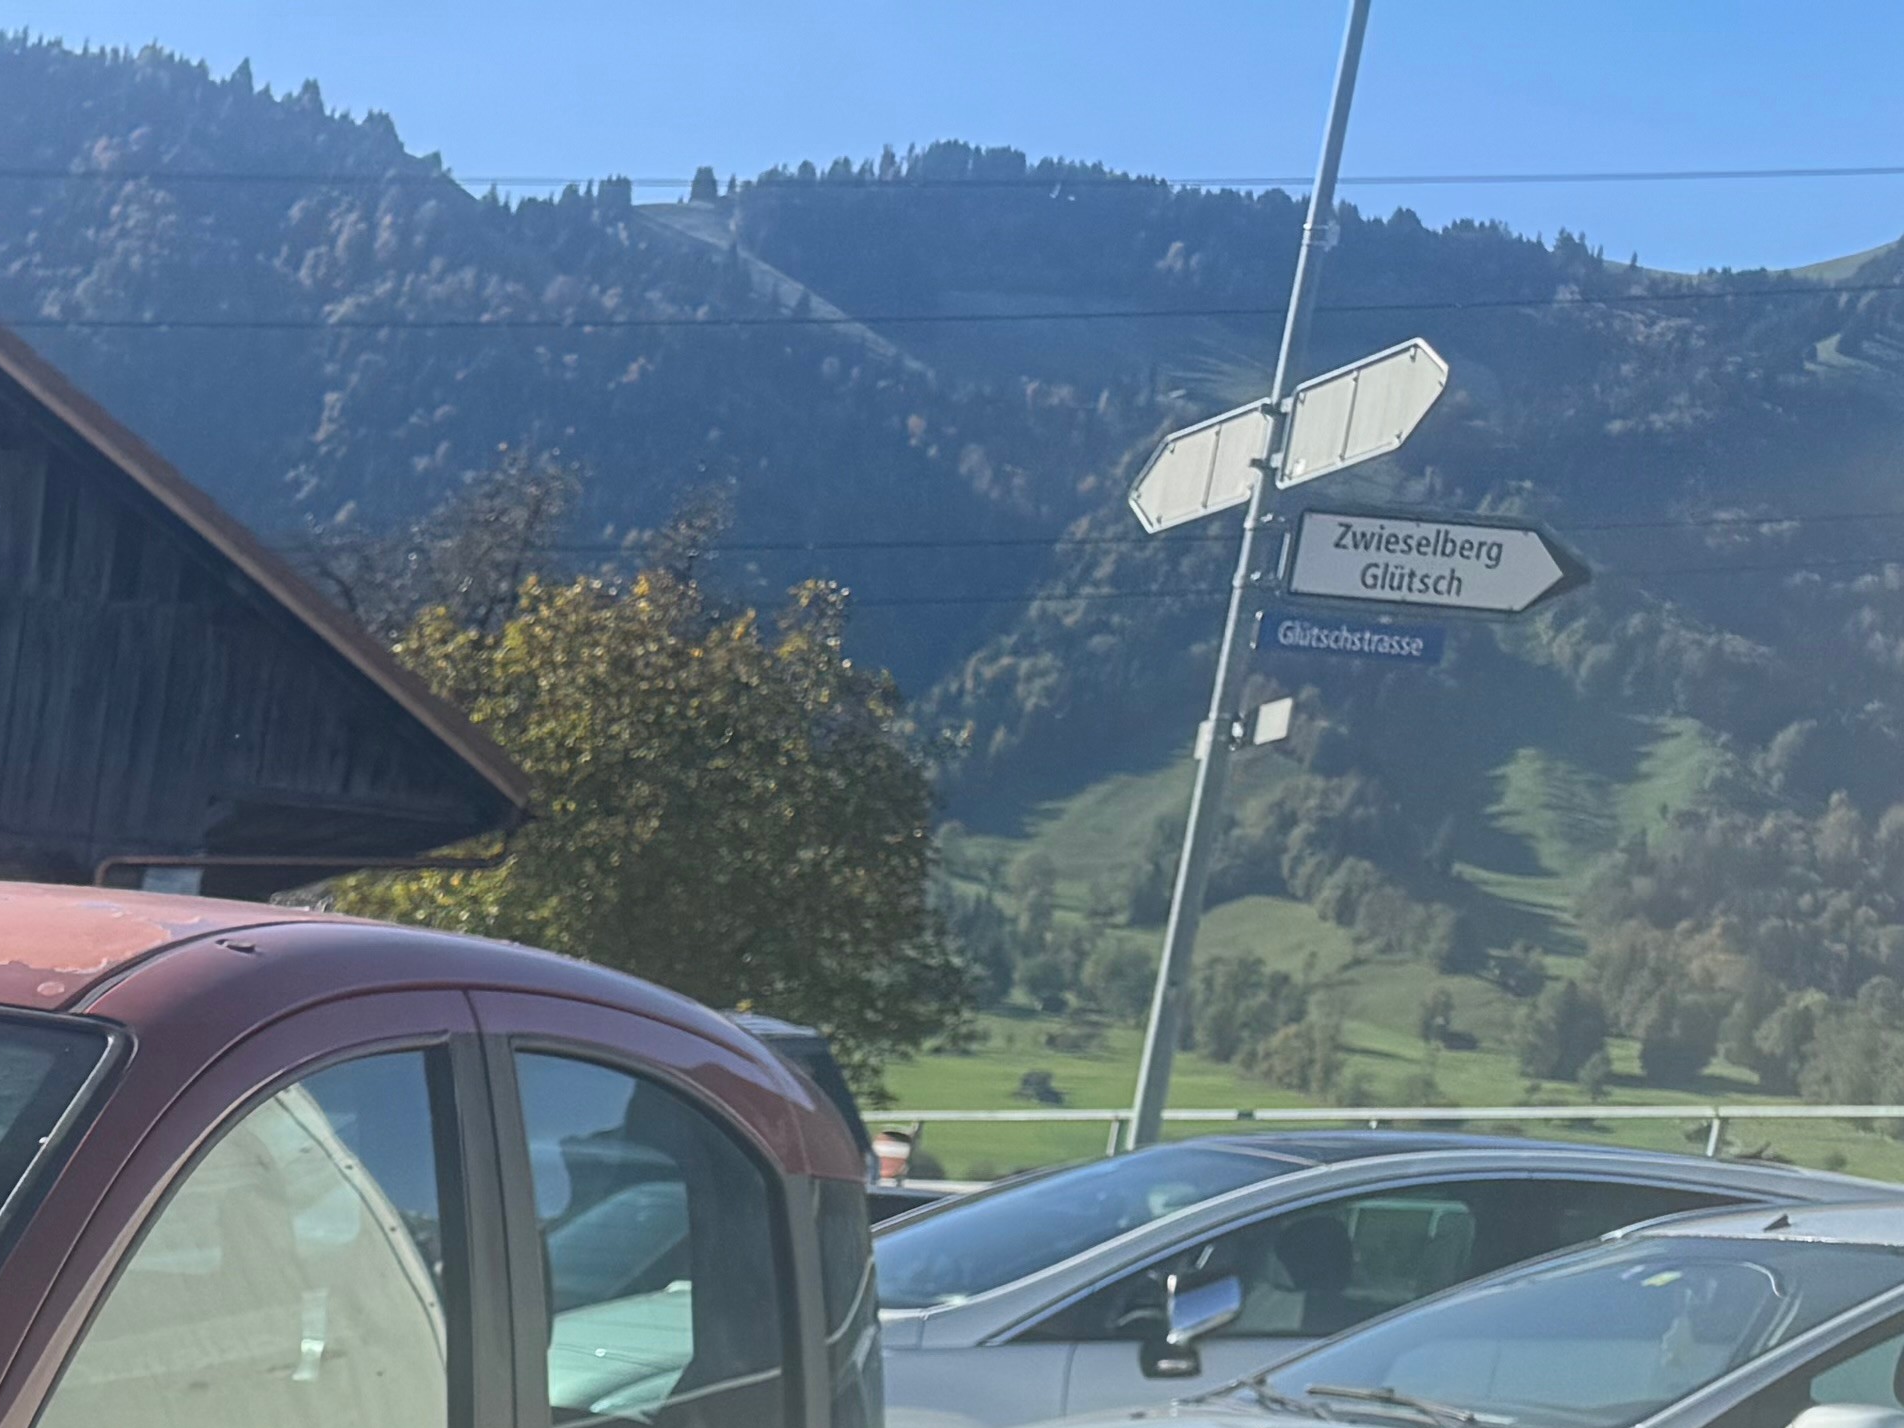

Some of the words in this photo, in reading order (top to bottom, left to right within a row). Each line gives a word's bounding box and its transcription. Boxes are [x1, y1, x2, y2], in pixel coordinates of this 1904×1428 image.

[1333, 524, 1503, 568] Zwieselberg
[1360, 562, 1463, 597] Glütsch
[1278, 621, 1423, 656] Glütschstrasse
